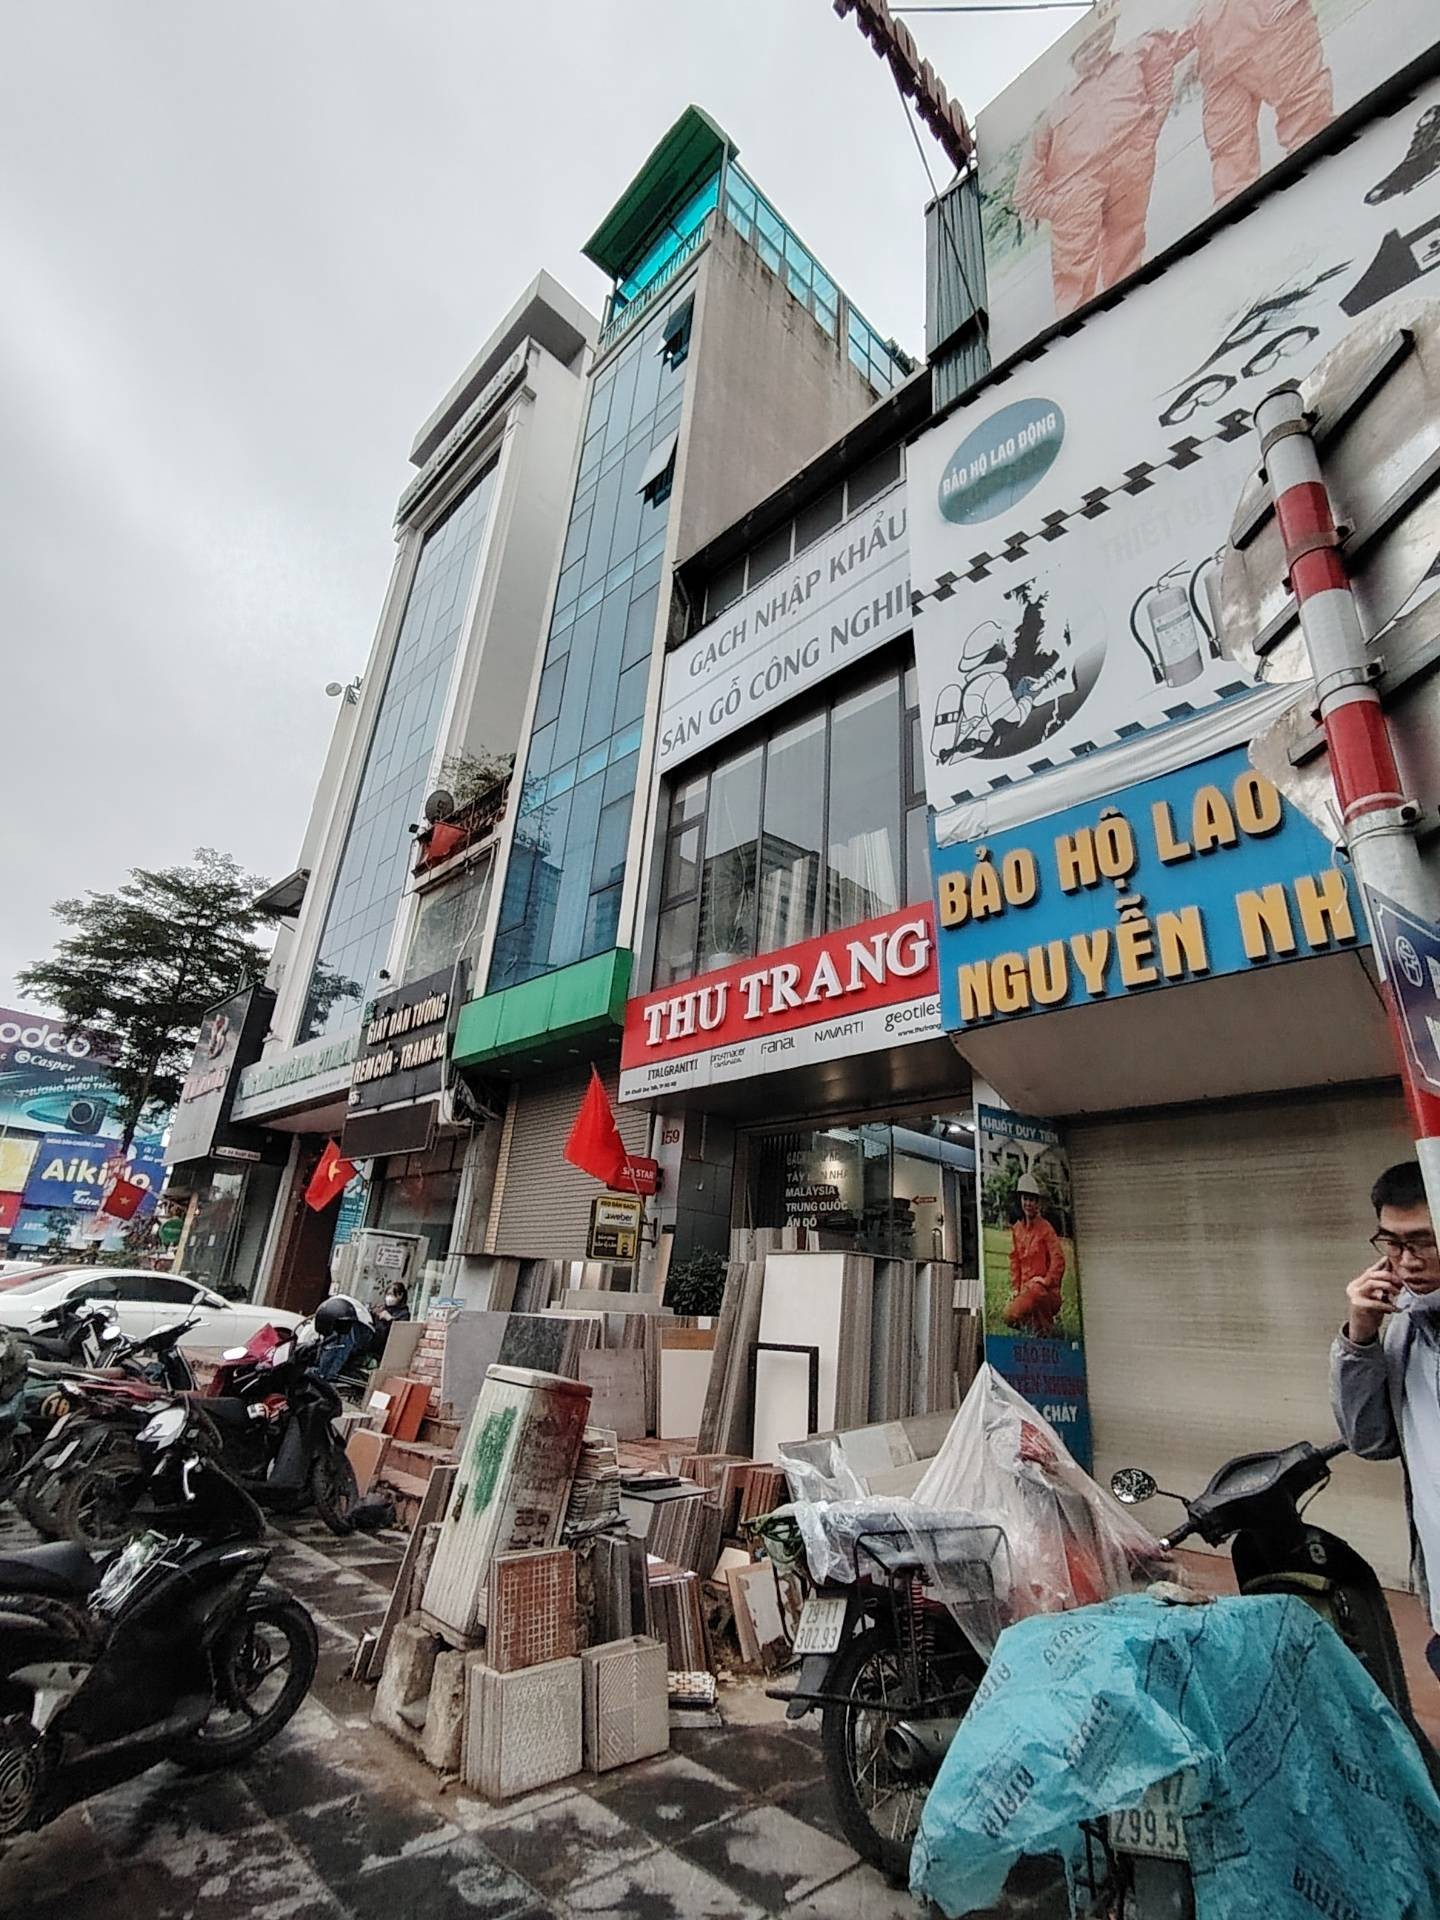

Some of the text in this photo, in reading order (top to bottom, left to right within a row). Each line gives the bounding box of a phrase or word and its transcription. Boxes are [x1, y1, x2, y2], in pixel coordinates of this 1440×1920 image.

[943, 467, 967, 496] BẢO
[970, 453, 987, 479] HỘ
[990, 438, 1015, 468] LAO
[689, 507, 908, 677] GẠCH NHẬP KHẨU
[660, 710, 702, 757] SÀN
[708, 675, 742, 726] GỖ
[749, 637, 821, 701] CÔNG
[938, 769, 1283, 929] BẢO HỘ LAO
[956, 894, 1209, 1022] NGUYỄN
[643, 918, 933, 1046] THU TRANG
[388, 1003, 412, 1037] DÁN
[647, 1059, 699, 1081] ITALGRANITI
[814, 1020, 864, 1042] NAVARTI
[884, 1001, 942, 1032] geotiles
[30, 1054, 76, 1072] Casper
[400, 1034, 435, 1070] TRANH
[661, 1129, 680, 1146] 159
[1015, 1124, 1036, 1139] DUY
[785, 1185, 836, 1198] MALAYSIA
[785, 1197, 848, 1213] TRUNG QUỐC
